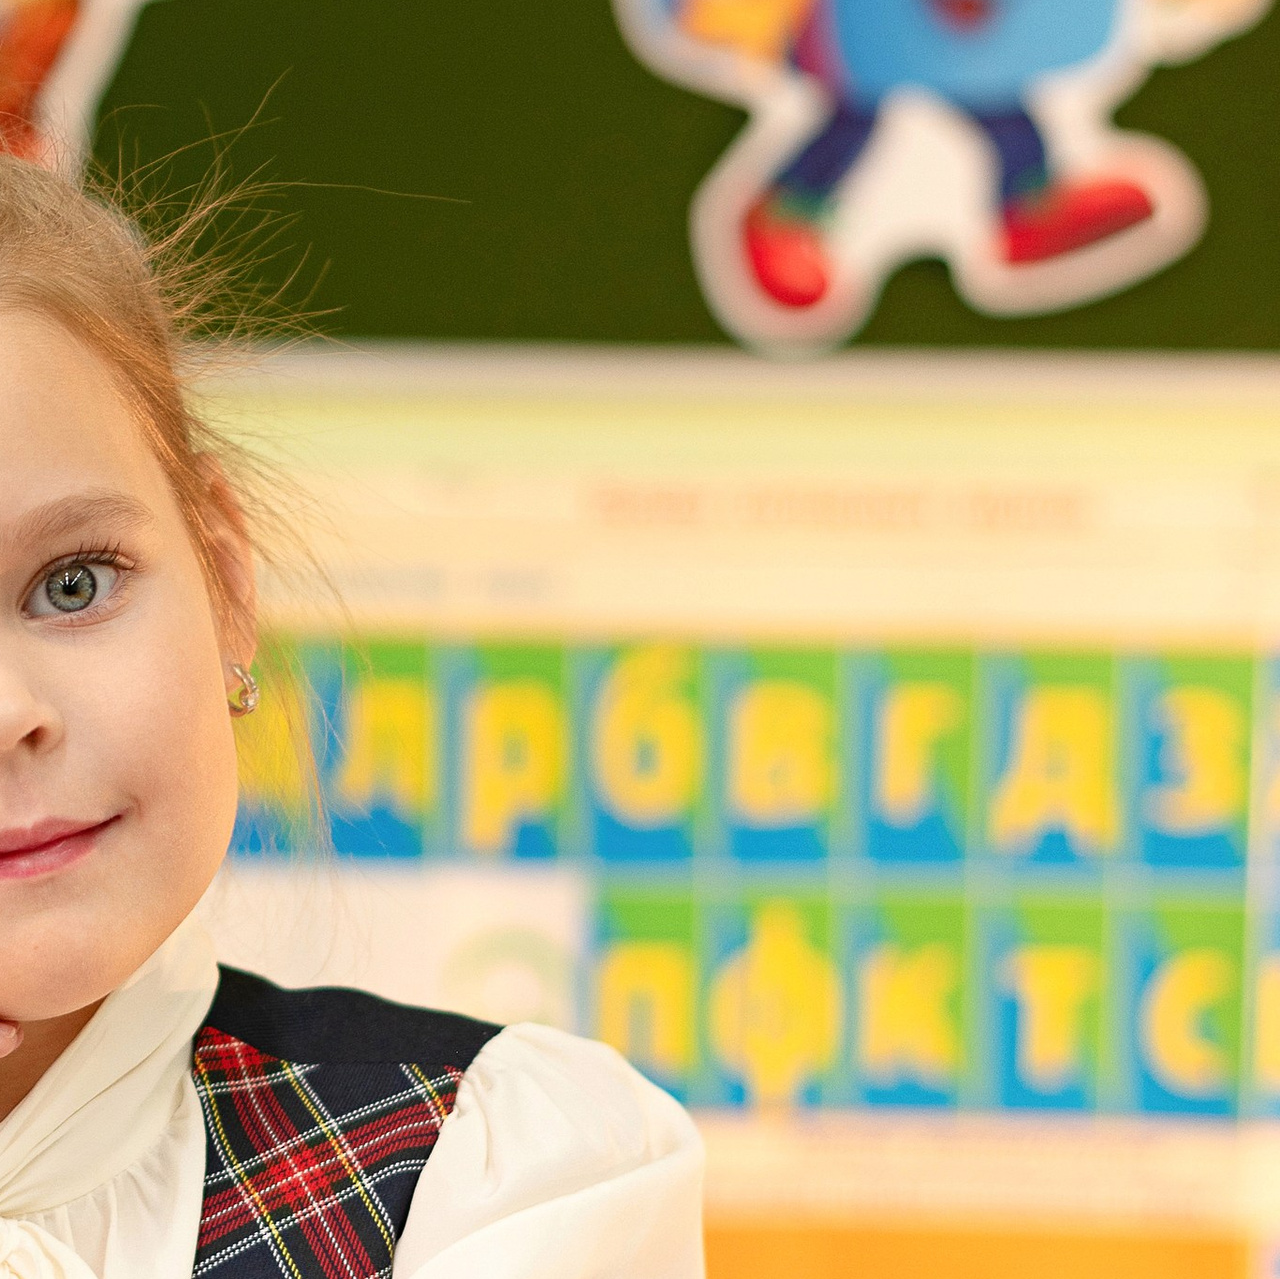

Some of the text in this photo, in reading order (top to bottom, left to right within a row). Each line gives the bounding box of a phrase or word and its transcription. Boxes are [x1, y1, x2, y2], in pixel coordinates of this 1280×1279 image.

[463, 679, 566, 851] р
[593, 639, 701, 826] б
[726, 680, 832, 821] в
[874, 680, 965, 824] г
[988, 682, 1115, 852] д
[594, 897, 1237, 1112] п ф к т с
